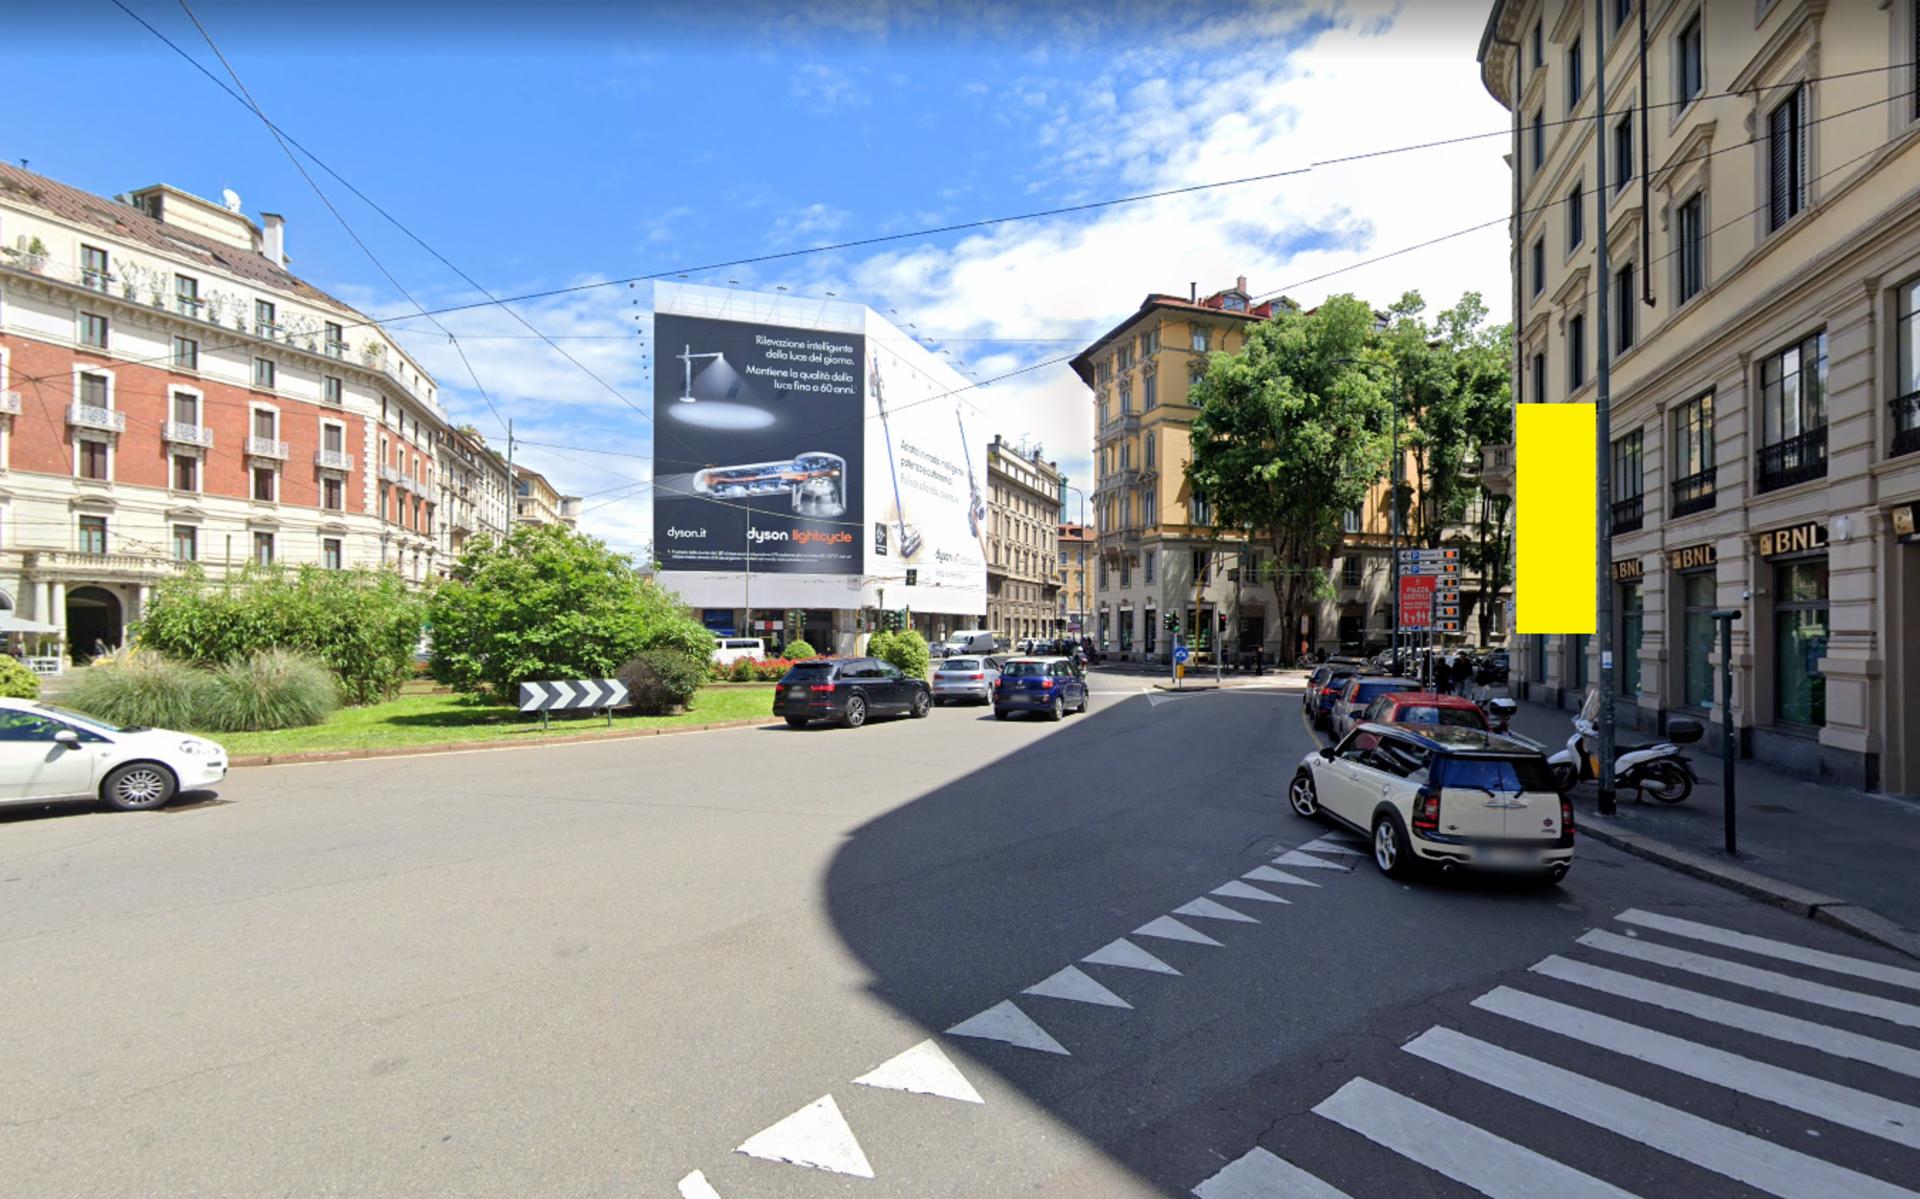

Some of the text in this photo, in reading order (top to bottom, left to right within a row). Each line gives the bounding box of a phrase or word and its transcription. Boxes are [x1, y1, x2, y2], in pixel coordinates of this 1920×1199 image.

[755, 334, 854, 354] Rilevazione intelligente
[765, 349, 788, 360] della
[789, 351, 808, 361] luce
[808, 352, 822, 363] del
[745, 364, 853, 383] Mantiene la qualità della
[773, 379, 792, 390] luce
[793, 380, 811, 391] fino
[812, 384, 819, 392] a
[820, 383, 833, 393] 60
[667, 526, 707, 540] dyson.it
[747, 527, 854, 545] dyson lightcycle
[1775, 524, 1826, 552] BNL
[1682, 545, 1716, 568] BNL
[1619, 560, 1643, 578] BNL
